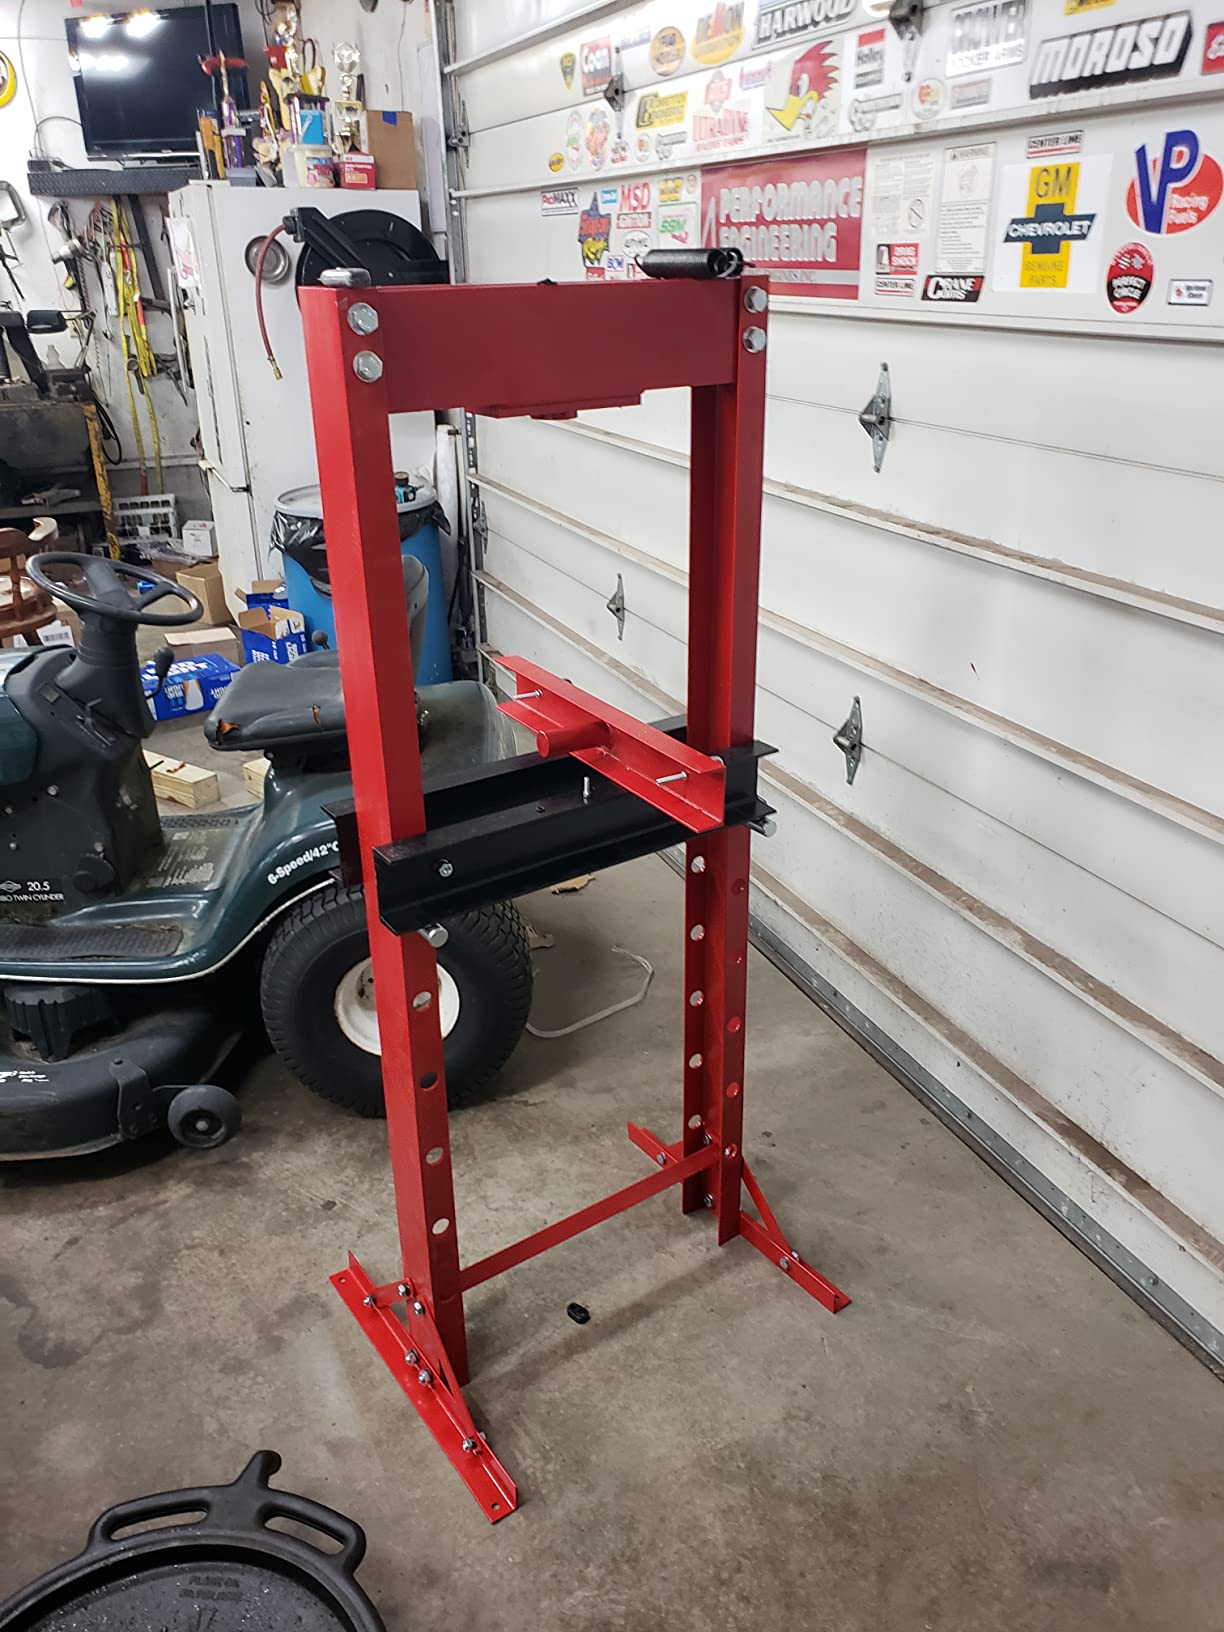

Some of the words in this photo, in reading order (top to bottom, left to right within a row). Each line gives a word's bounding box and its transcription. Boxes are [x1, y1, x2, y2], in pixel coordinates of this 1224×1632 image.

[758, 0, 855, 43] HARWOOD
[1031, 15, 1190, 84] MOROSO
[719, 176, 863, 223] PERFORMANCE
[1036, 167, 1072, 198] GM
[1135, 129, 1199, 234] VP
[719, 222, 838, 262] ENGINEERING
[1008, 220, 1092, 237] CHEVROLET
[26, 881, 51, 891] 20.5
